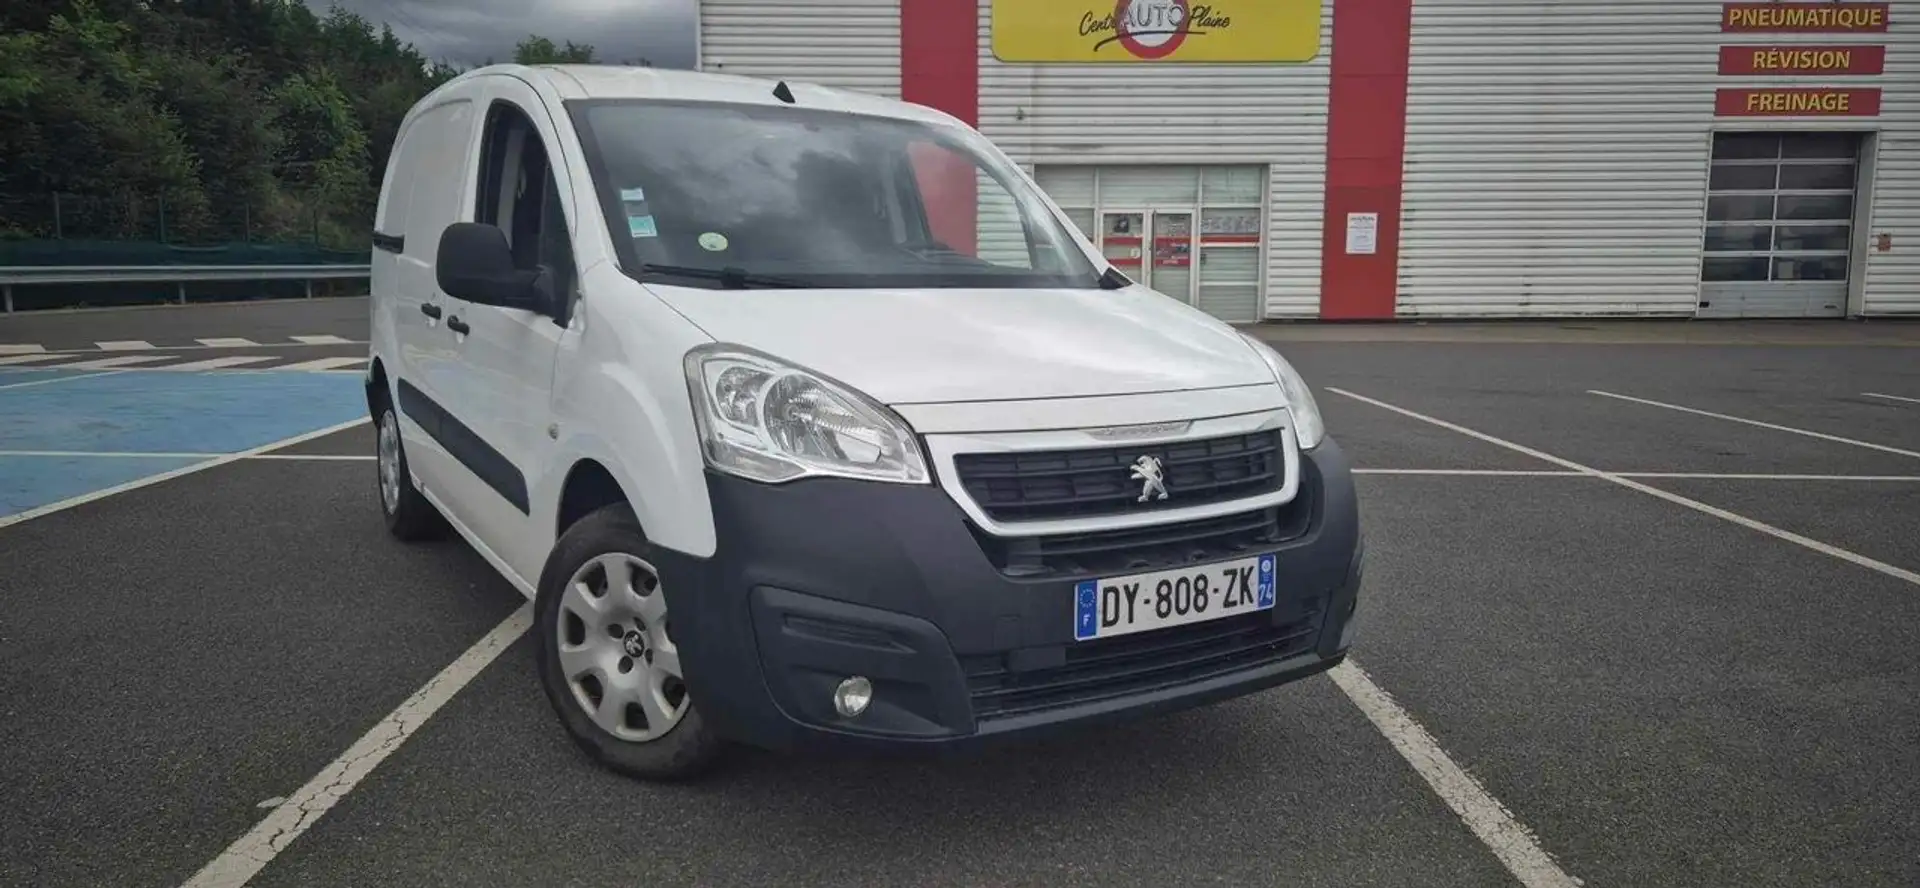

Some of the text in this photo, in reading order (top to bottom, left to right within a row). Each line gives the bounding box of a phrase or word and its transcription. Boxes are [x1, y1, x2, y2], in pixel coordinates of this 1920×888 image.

[1122, 3, 1184, 27] AUTO
[1187, 5, 1230, 29] Plaine
[1729, 8, 1882, 28] PNEUMATIQUE
[1753, 48, 1851, 69] RÉVISION
[1747, 93, 1850, 111] FREINAGE
[1083, 565, 1273, 628] F DY-808-ZK 74
